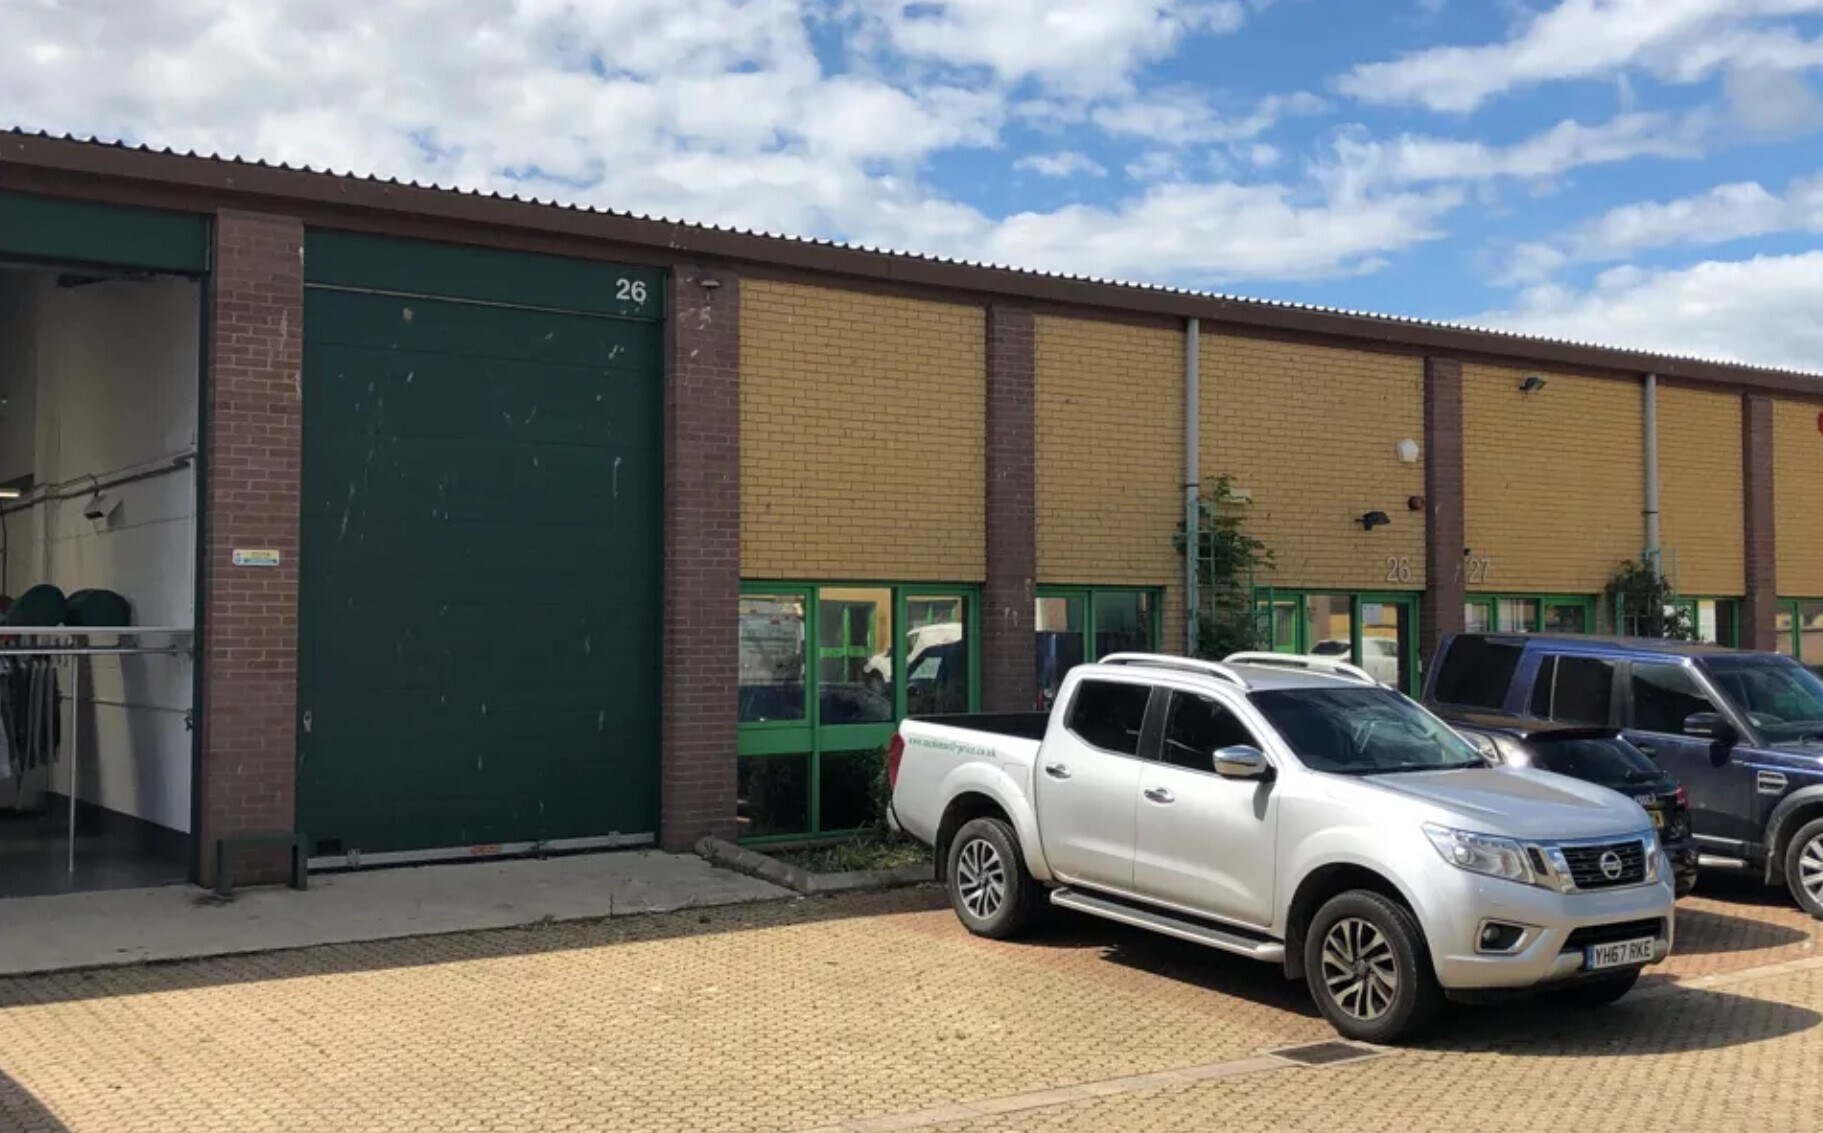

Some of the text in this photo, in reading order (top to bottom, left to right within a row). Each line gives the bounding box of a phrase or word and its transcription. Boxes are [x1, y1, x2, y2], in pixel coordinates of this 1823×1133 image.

[616, 279, 647, 302] 26
[1386, 556, 1411, 582] 26
[1468, 559, 1491, 583] 27
[1595, 941, 1651, 965] YH67 RKE
